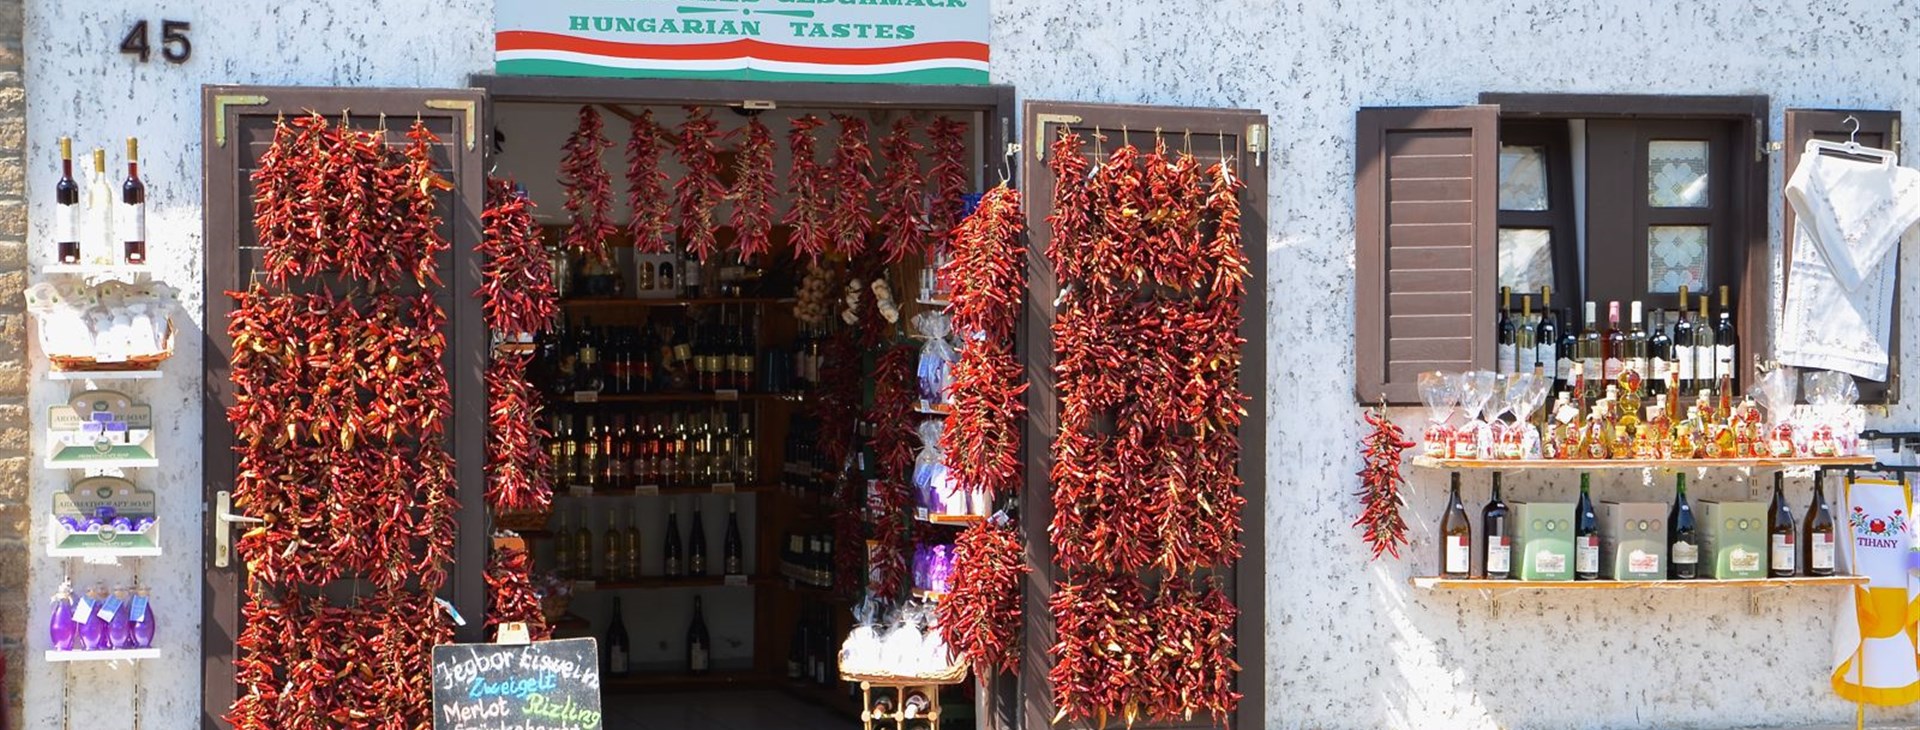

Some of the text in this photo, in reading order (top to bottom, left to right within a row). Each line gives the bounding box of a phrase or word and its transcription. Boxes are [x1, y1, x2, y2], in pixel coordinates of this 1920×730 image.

[120, 19, 191, 64] 45
[569, 16, 915, 39] HUNGARIAN TASTES
[1857, 537, 1898, 549] TIHANY
[469, 669, 557, 698] Zweigelt
[443, 692, 601, 729] Merlot Rizling
